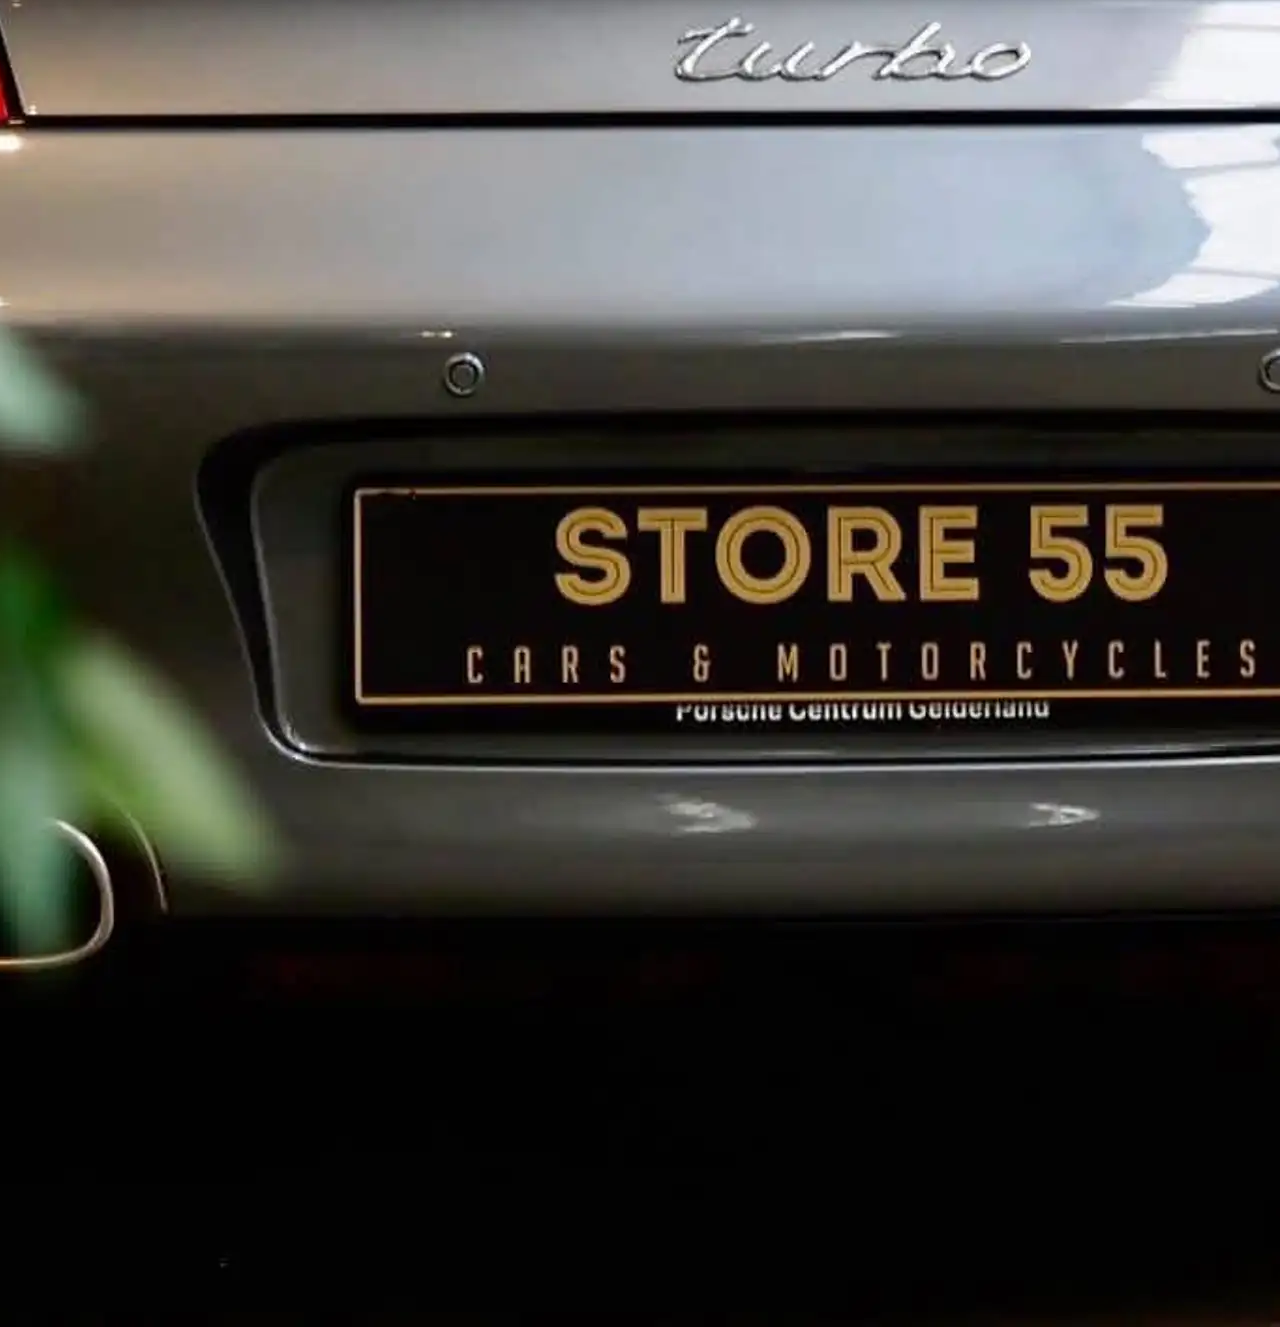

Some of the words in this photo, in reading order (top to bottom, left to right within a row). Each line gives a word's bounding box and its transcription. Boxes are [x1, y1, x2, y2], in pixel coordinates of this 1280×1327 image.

[674, 17, 1033, 82] turbo
[554, 505, 981, 605] STORE
[1027, 504, 1169, 603] 55
[465, 645, 627, 685] CARS
[692, 644, 712, 684] &
[776, 639, 1258, 683] MOTORCYCLES
